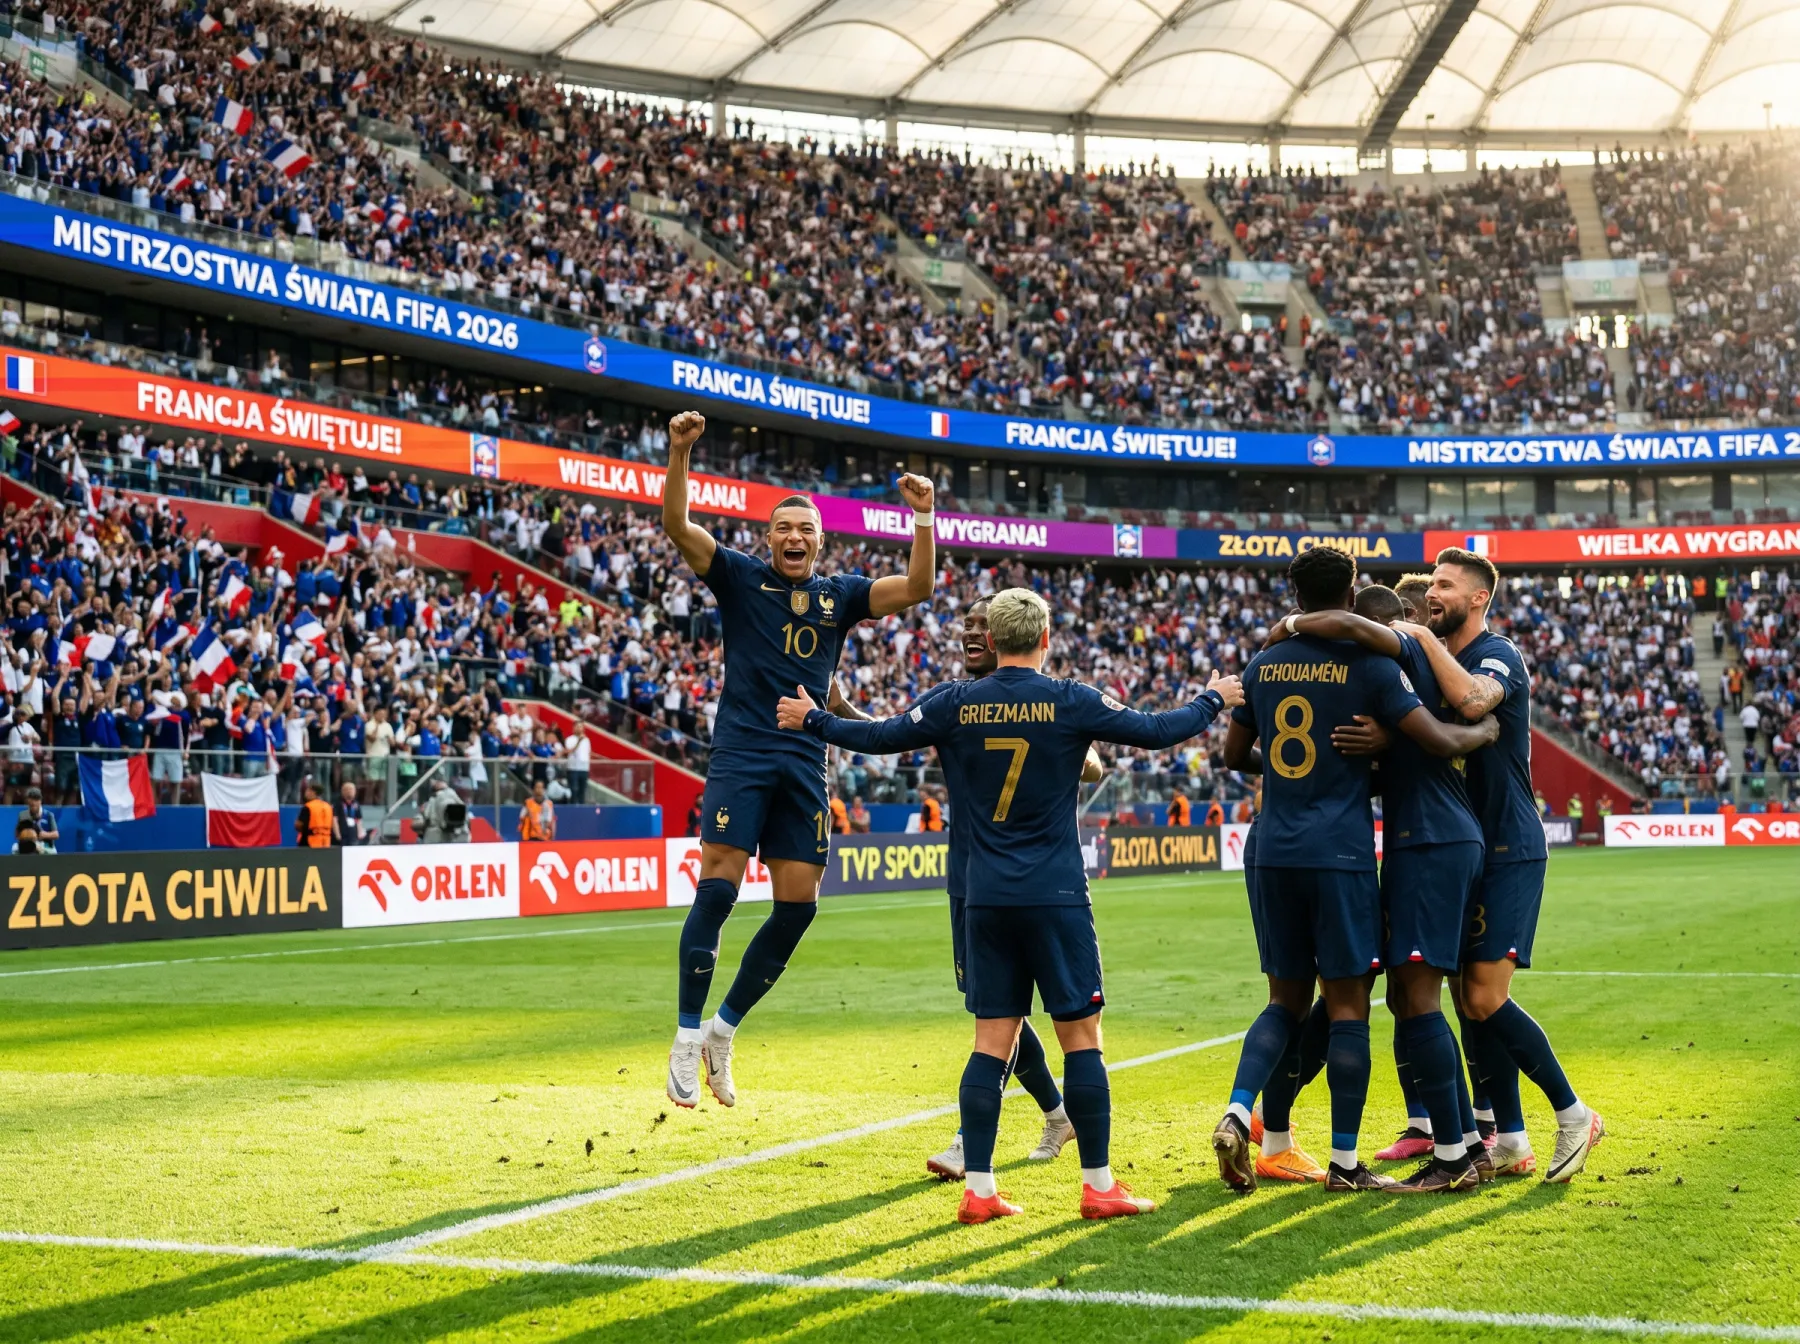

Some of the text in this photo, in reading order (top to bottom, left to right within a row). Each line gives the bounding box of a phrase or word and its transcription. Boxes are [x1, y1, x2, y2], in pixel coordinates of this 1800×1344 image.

[53, 214, 519, 350] MISTRZOSTWA ŚWIATA FIFA 2026
[672, 358, 871, 424] FRANCJA ŚWIĘTUJE!
[137, 381, 403, 456] FRANCJA ŚWIĘTUJE!
[1005, 421, 1237, 461] FRANCJA ŚWIĘTUJE!
[1408, 439, 1604, 464] MISTRZOSTWA
[1608, 433, 1714, 461] ŚWIATA
[1718, 433, 1780, 457] FIFA
[558, 456, 748, 512] WIELKA WRANA!
[862, 506, 1048, 548] WIELK WYGRANA!
[1218, 534, 1294, 557] ZŁOTA
[1577, 532, 1681, 557] WIELKA
[782, 622, 818, 658] 10
[1258, 660, 1349, 685] TCHOUAMÉNI
[959, 702, 1056, 726] GRIEZMANN
[1269, 694, 1317, 780] 8
[984, 737, 1030, 822] 7
[1648, 824, 1715, 837] ORLEN
[837, 843, 949, 882] TVP SPORT
[1110, 837, 1159, 868] ZŁOTA
[1160, 835, 1218, 866] CHWILA
[411, 863, 506, 902] ORLEN
[573, 856, 659, 895] ORLEN
[8, 865, 328, 929] ZŁOTA CHWILA
